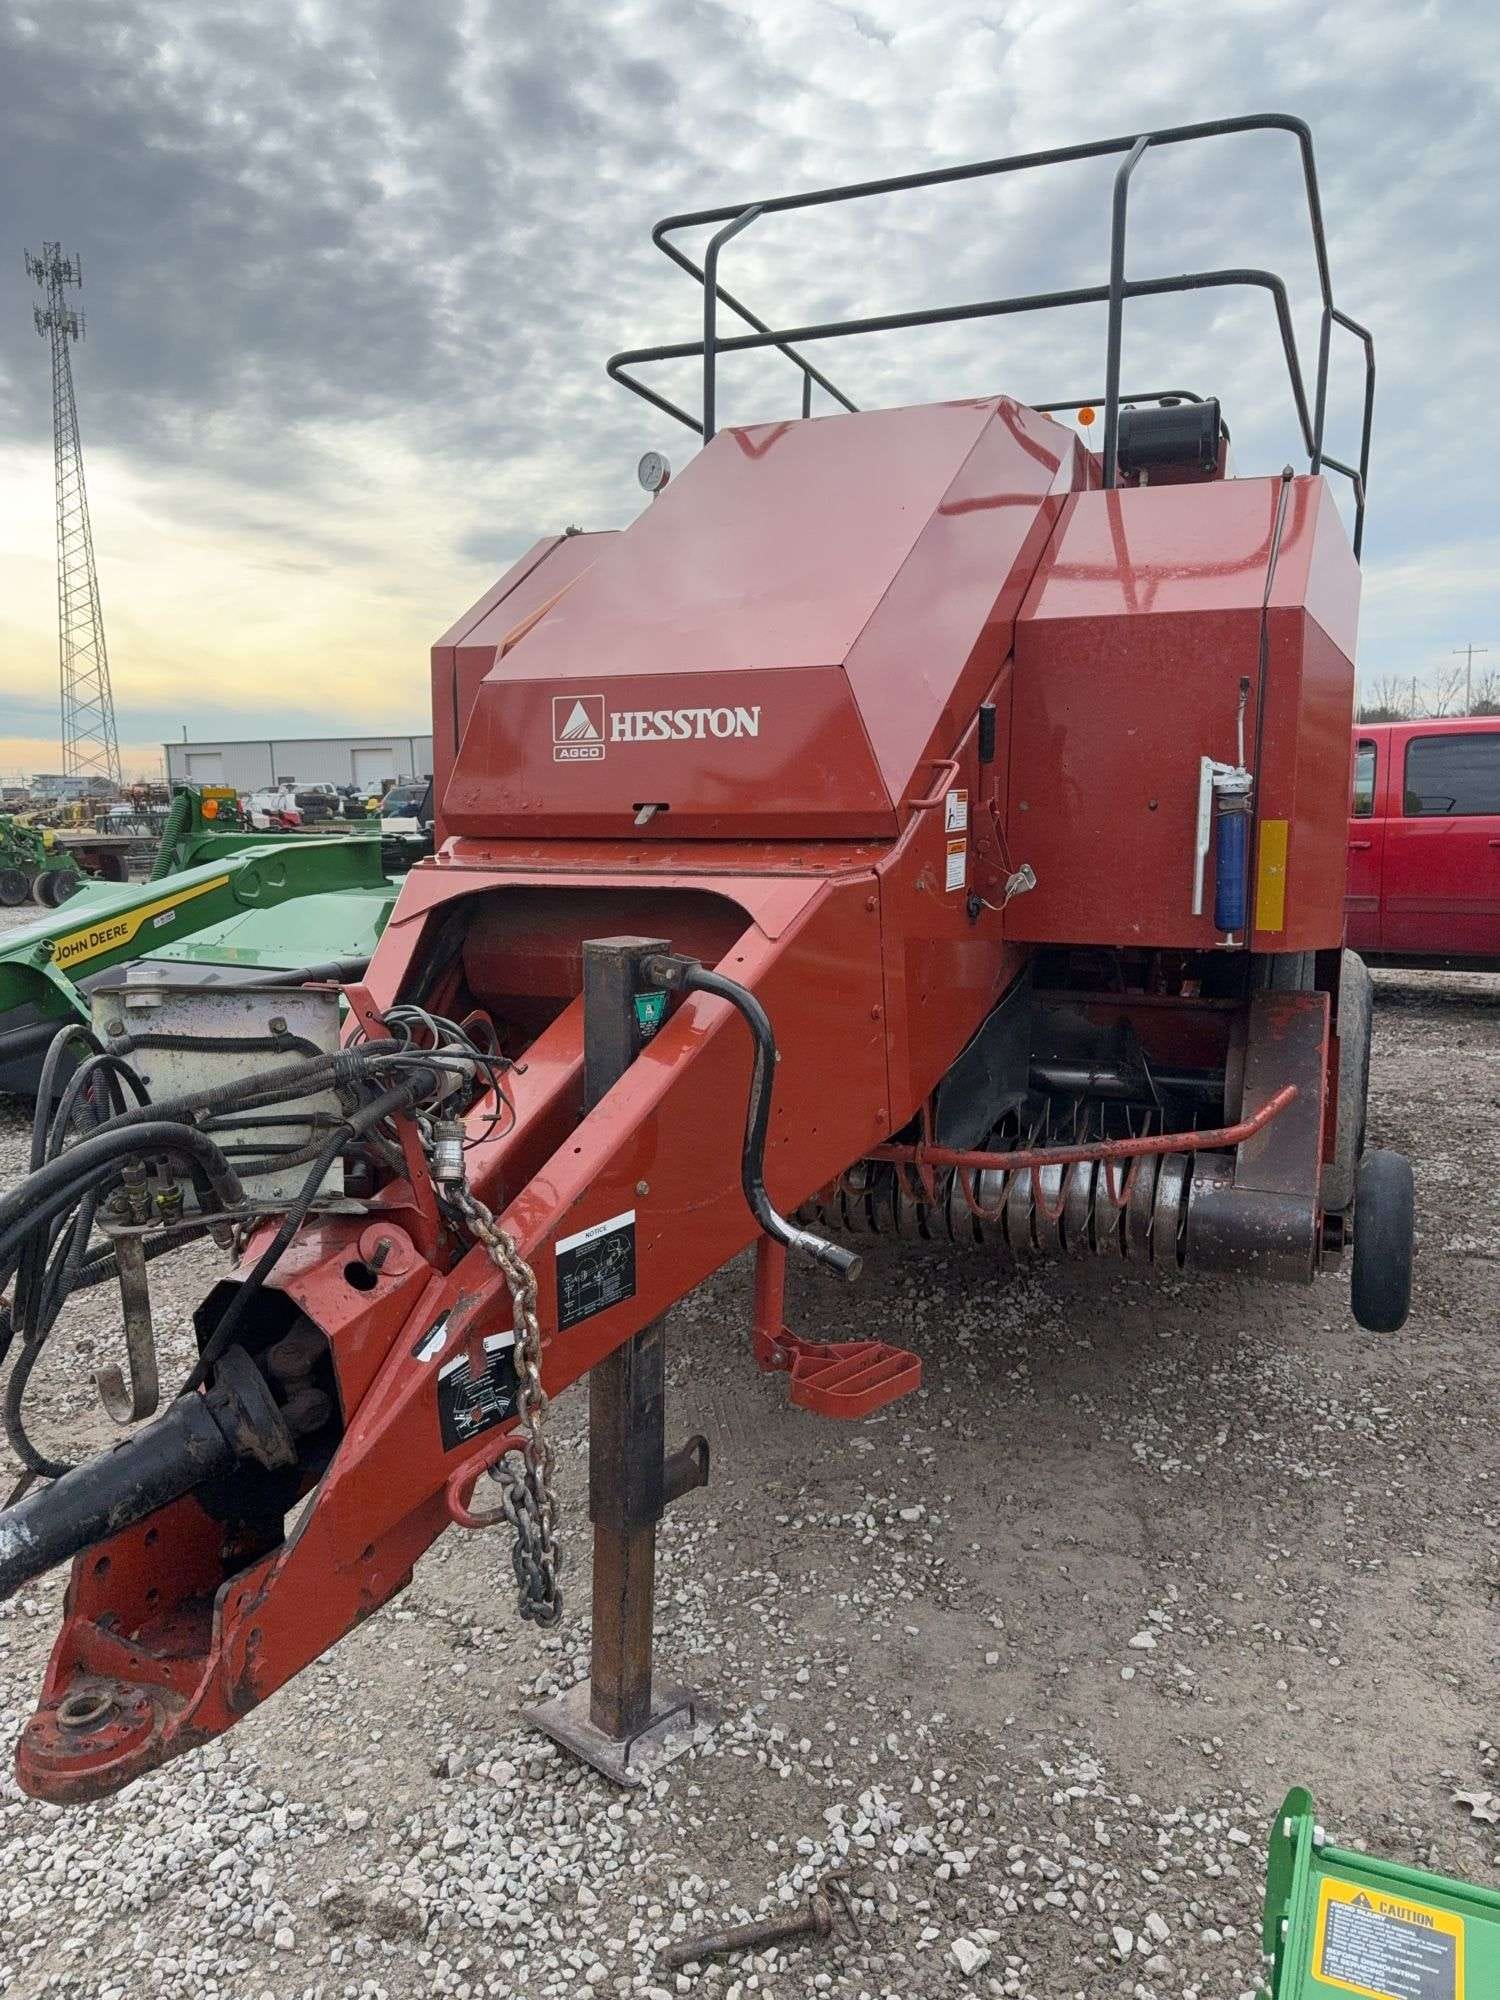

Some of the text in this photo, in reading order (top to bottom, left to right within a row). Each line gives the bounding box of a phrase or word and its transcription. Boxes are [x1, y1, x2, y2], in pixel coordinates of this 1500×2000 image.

[610, 706, 761, 742] HESSTON
[559, 747, 600, 759] AGCO
[56, 923, 128, 962] JOHN DEERE
[585, 1224, 608, 1239] NOTICE
[1379, 1902, 1434, 1928] CAUTION
[1326, 1947, 1358, 1962] BEFORE
[1360, 1957, 1420, 1981] DISMOUNTING
